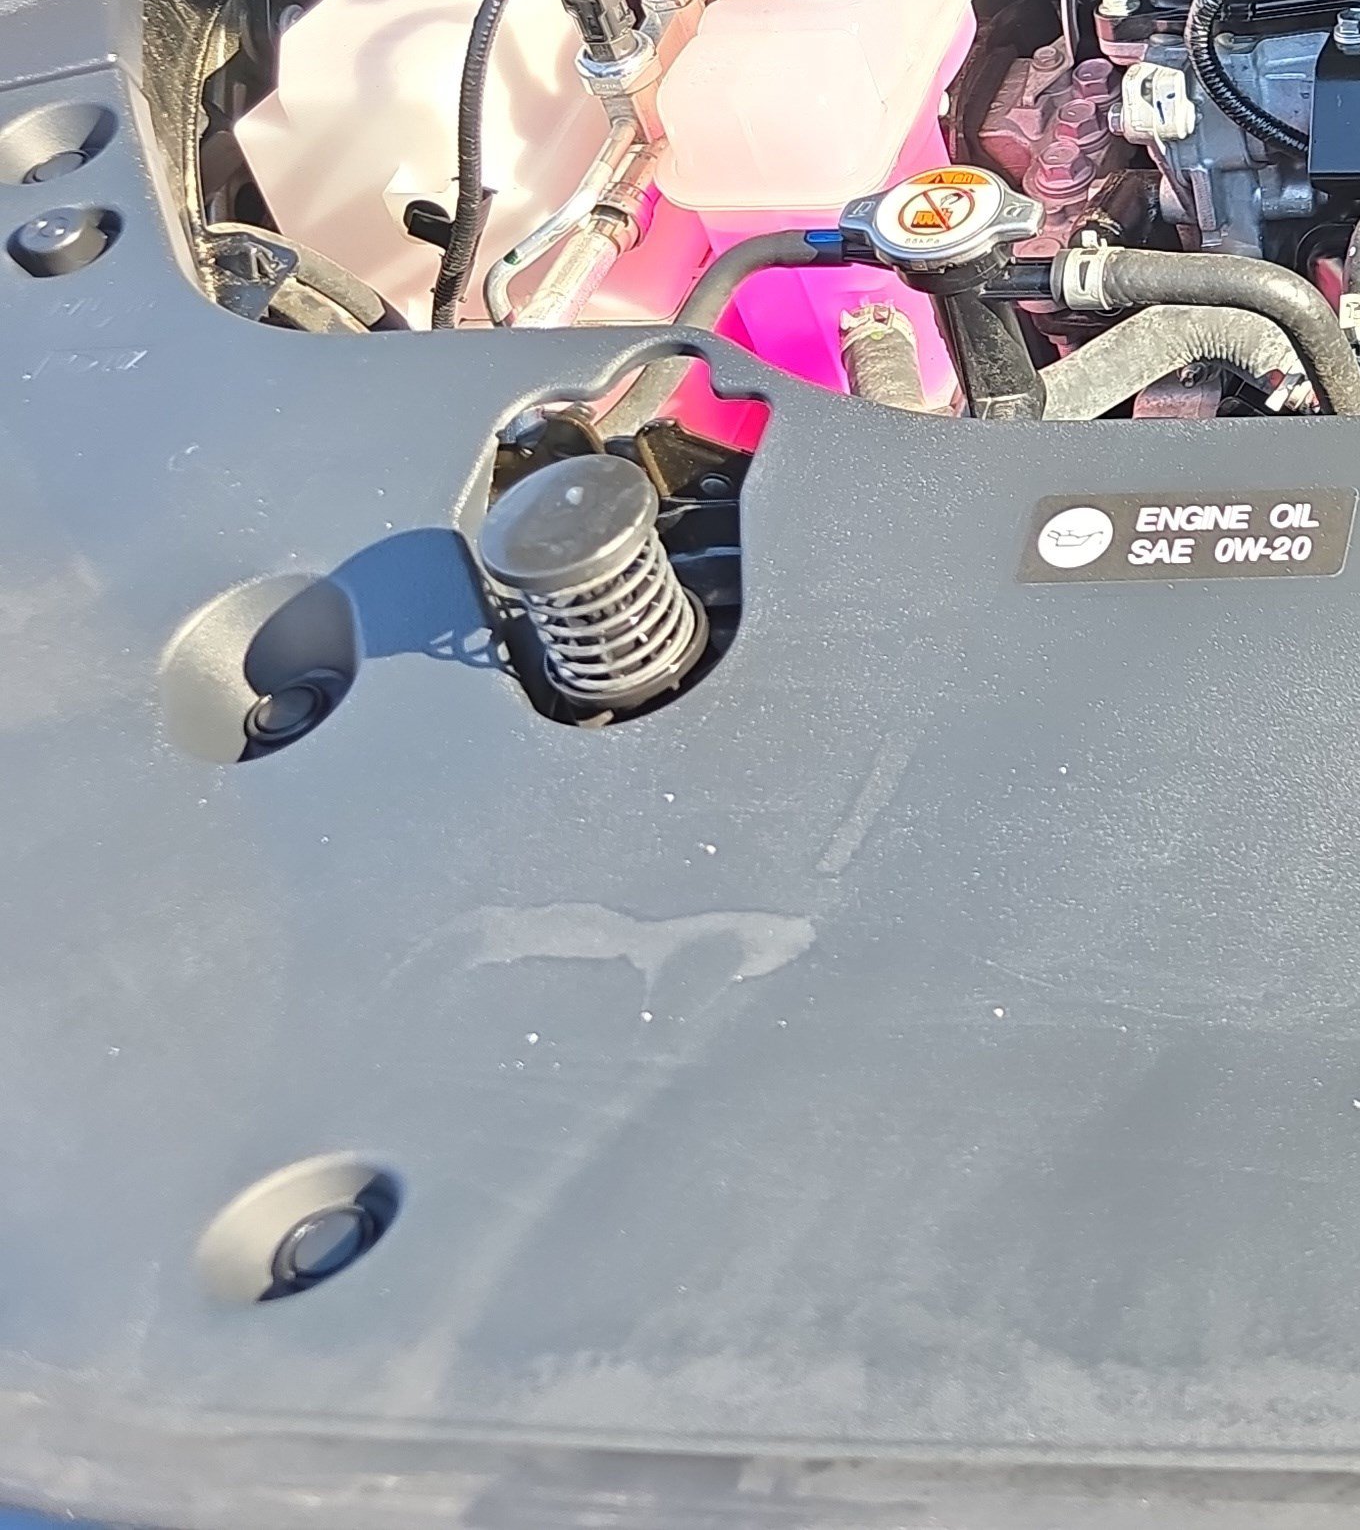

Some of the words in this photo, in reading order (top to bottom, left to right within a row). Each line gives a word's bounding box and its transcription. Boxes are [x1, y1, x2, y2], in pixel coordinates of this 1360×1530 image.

[1135, 504, 1252, 532] ENGINE
[1269, 503, 1320, 529] OIL
[1127, 538, 1194, 565] SAE
[1214, 536, 1313, 564] 0W-20
